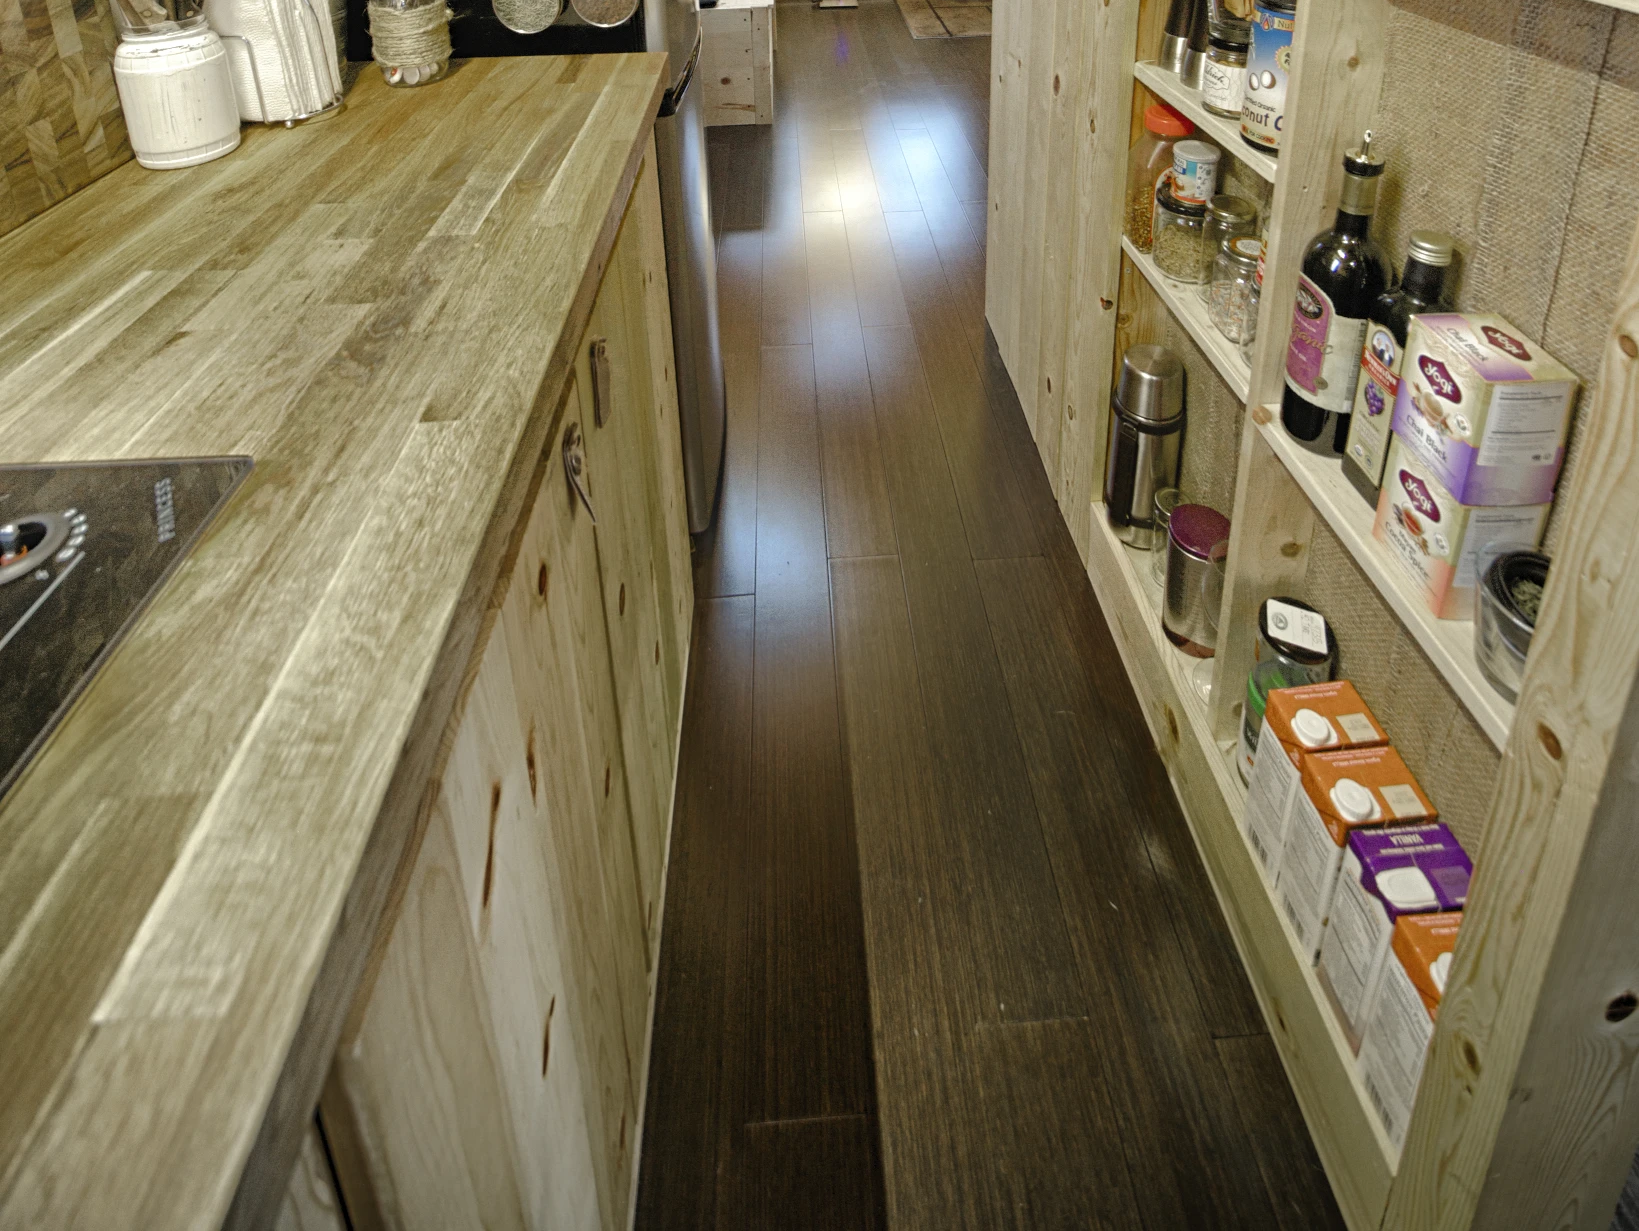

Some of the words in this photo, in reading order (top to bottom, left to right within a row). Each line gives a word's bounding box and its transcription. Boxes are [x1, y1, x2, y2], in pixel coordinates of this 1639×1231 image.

[1464, 343, 1489, 362] Black
[1407, 414, 1424, 438] Chai
[1426, 435, 1447, 463] Black
[1408, 549, 1431, 579] Spice
